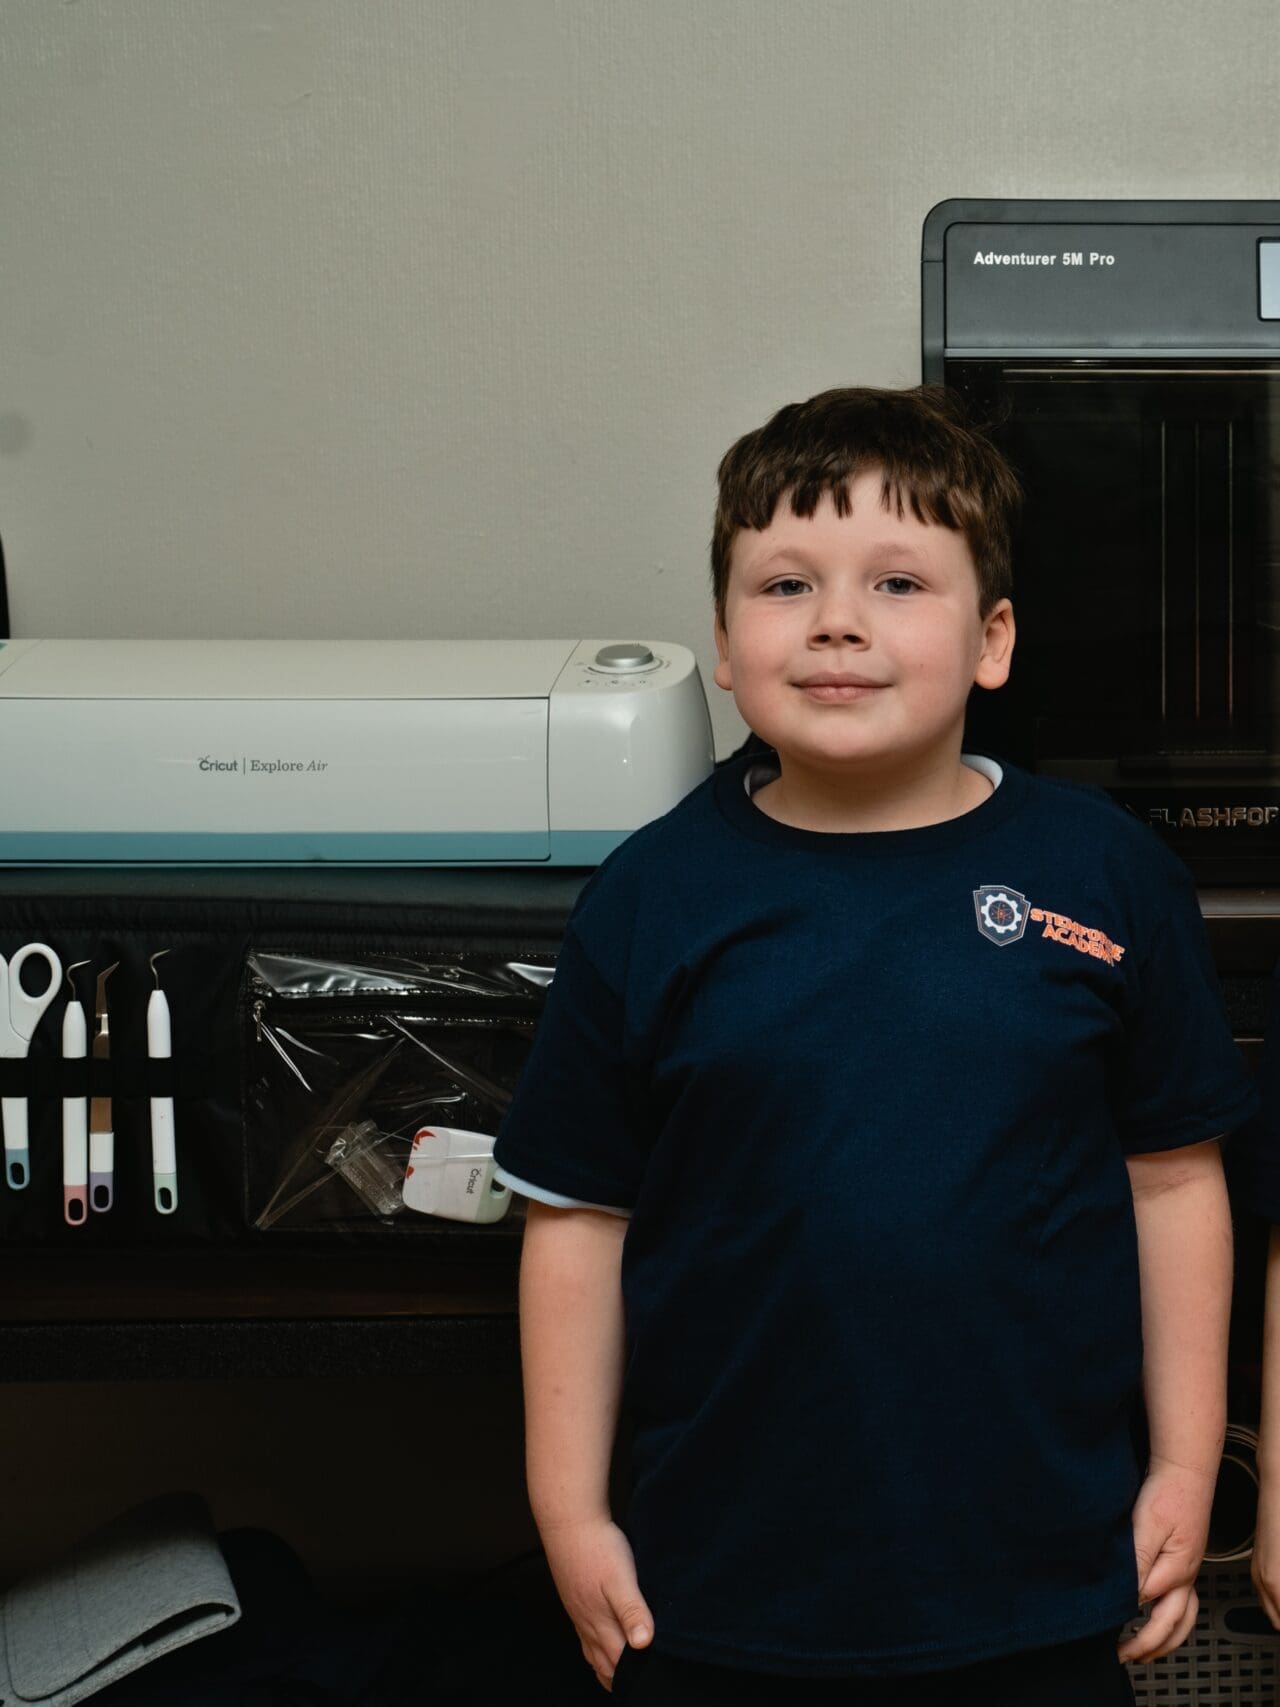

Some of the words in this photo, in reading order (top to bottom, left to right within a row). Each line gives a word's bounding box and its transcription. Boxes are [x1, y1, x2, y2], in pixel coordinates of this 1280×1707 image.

[973, 251, 1057, 266] Adventurer
[1062, 252, 1083, 266] 5M
[1089, 252, 1116, 266] Pro
[198, 755, 238, 771] Cricut
[250, 759, 304, 773] Explore
[306, 759, 329, 771] Air
[466, 1168, 481, 1194] Cricut
